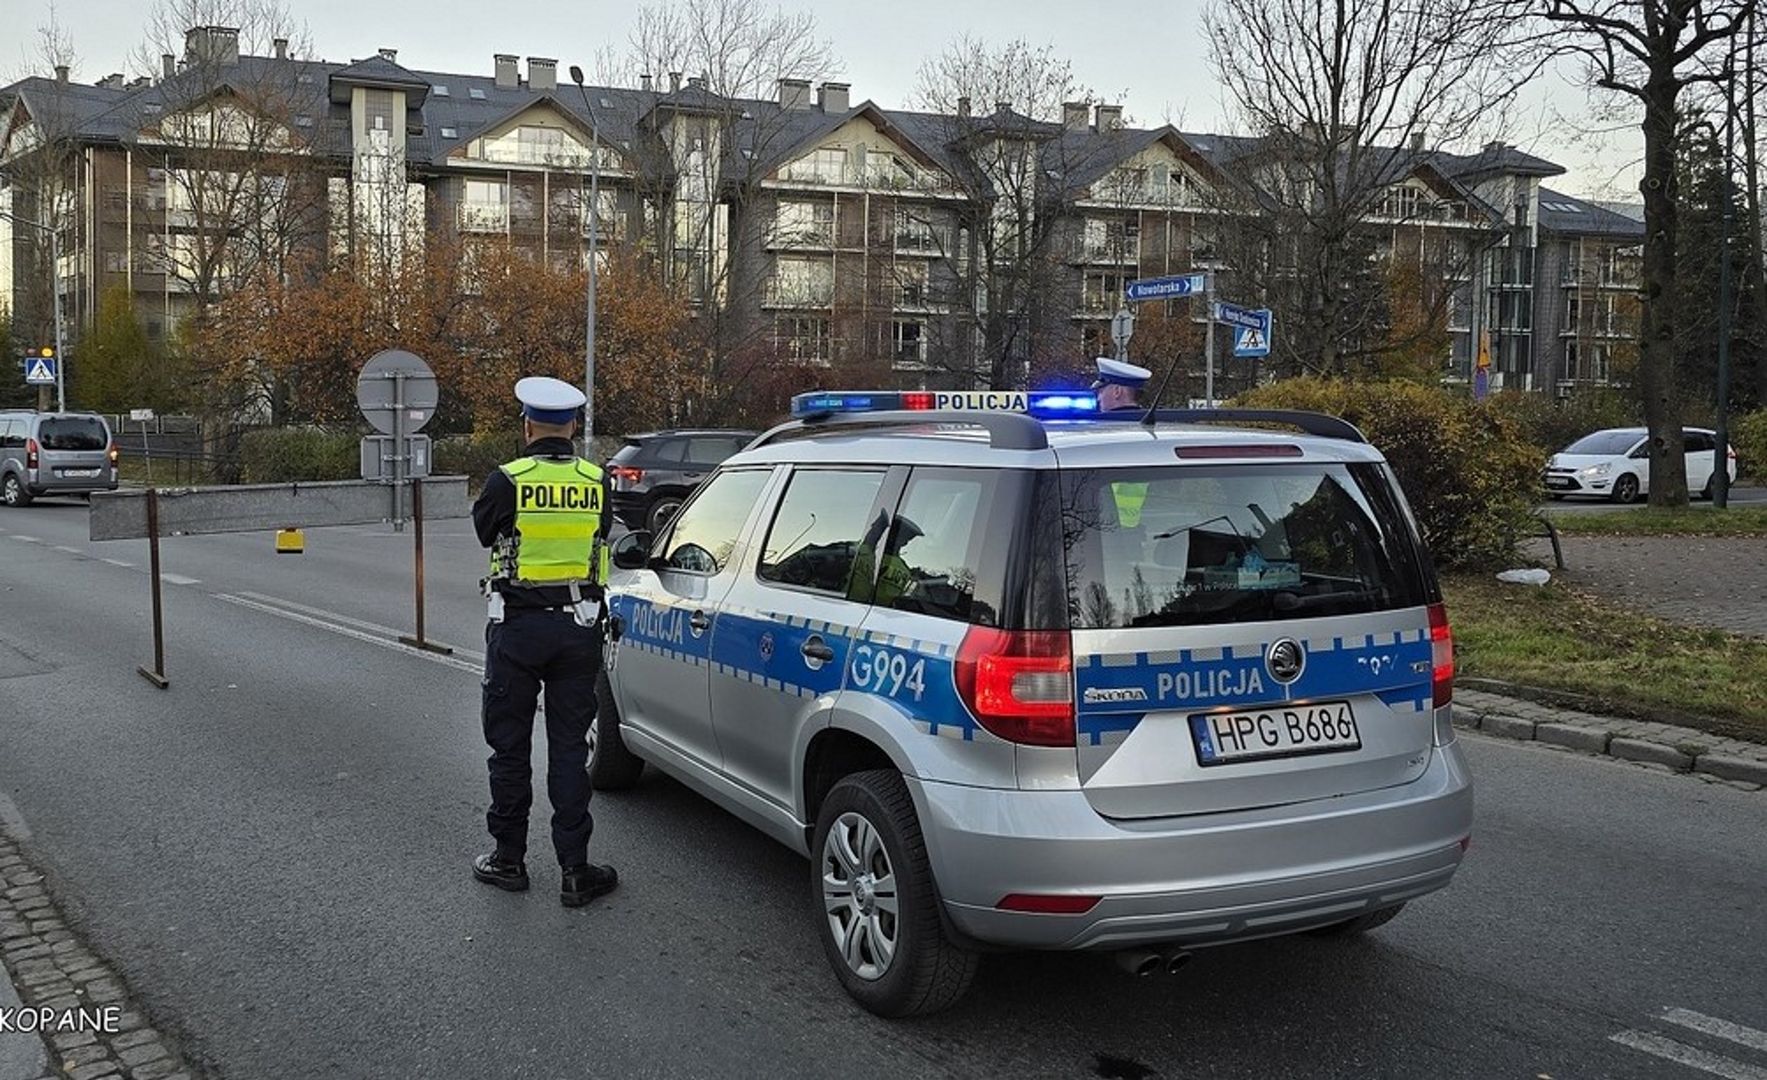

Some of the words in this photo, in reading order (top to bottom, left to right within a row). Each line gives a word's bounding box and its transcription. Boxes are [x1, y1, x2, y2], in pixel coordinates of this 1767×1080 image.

[938, 394, 1025, 410] POLICJA
[521, 484, 600, 510] POLICJA
[631, 602, 684, 646] POLICJA
[851, 644, 926, 703] G994
[1156, 667, 1265, 701] POLICJA
[1211, 714, 1279, 753] HPG
[1284, 707, 1351, 745] B686
